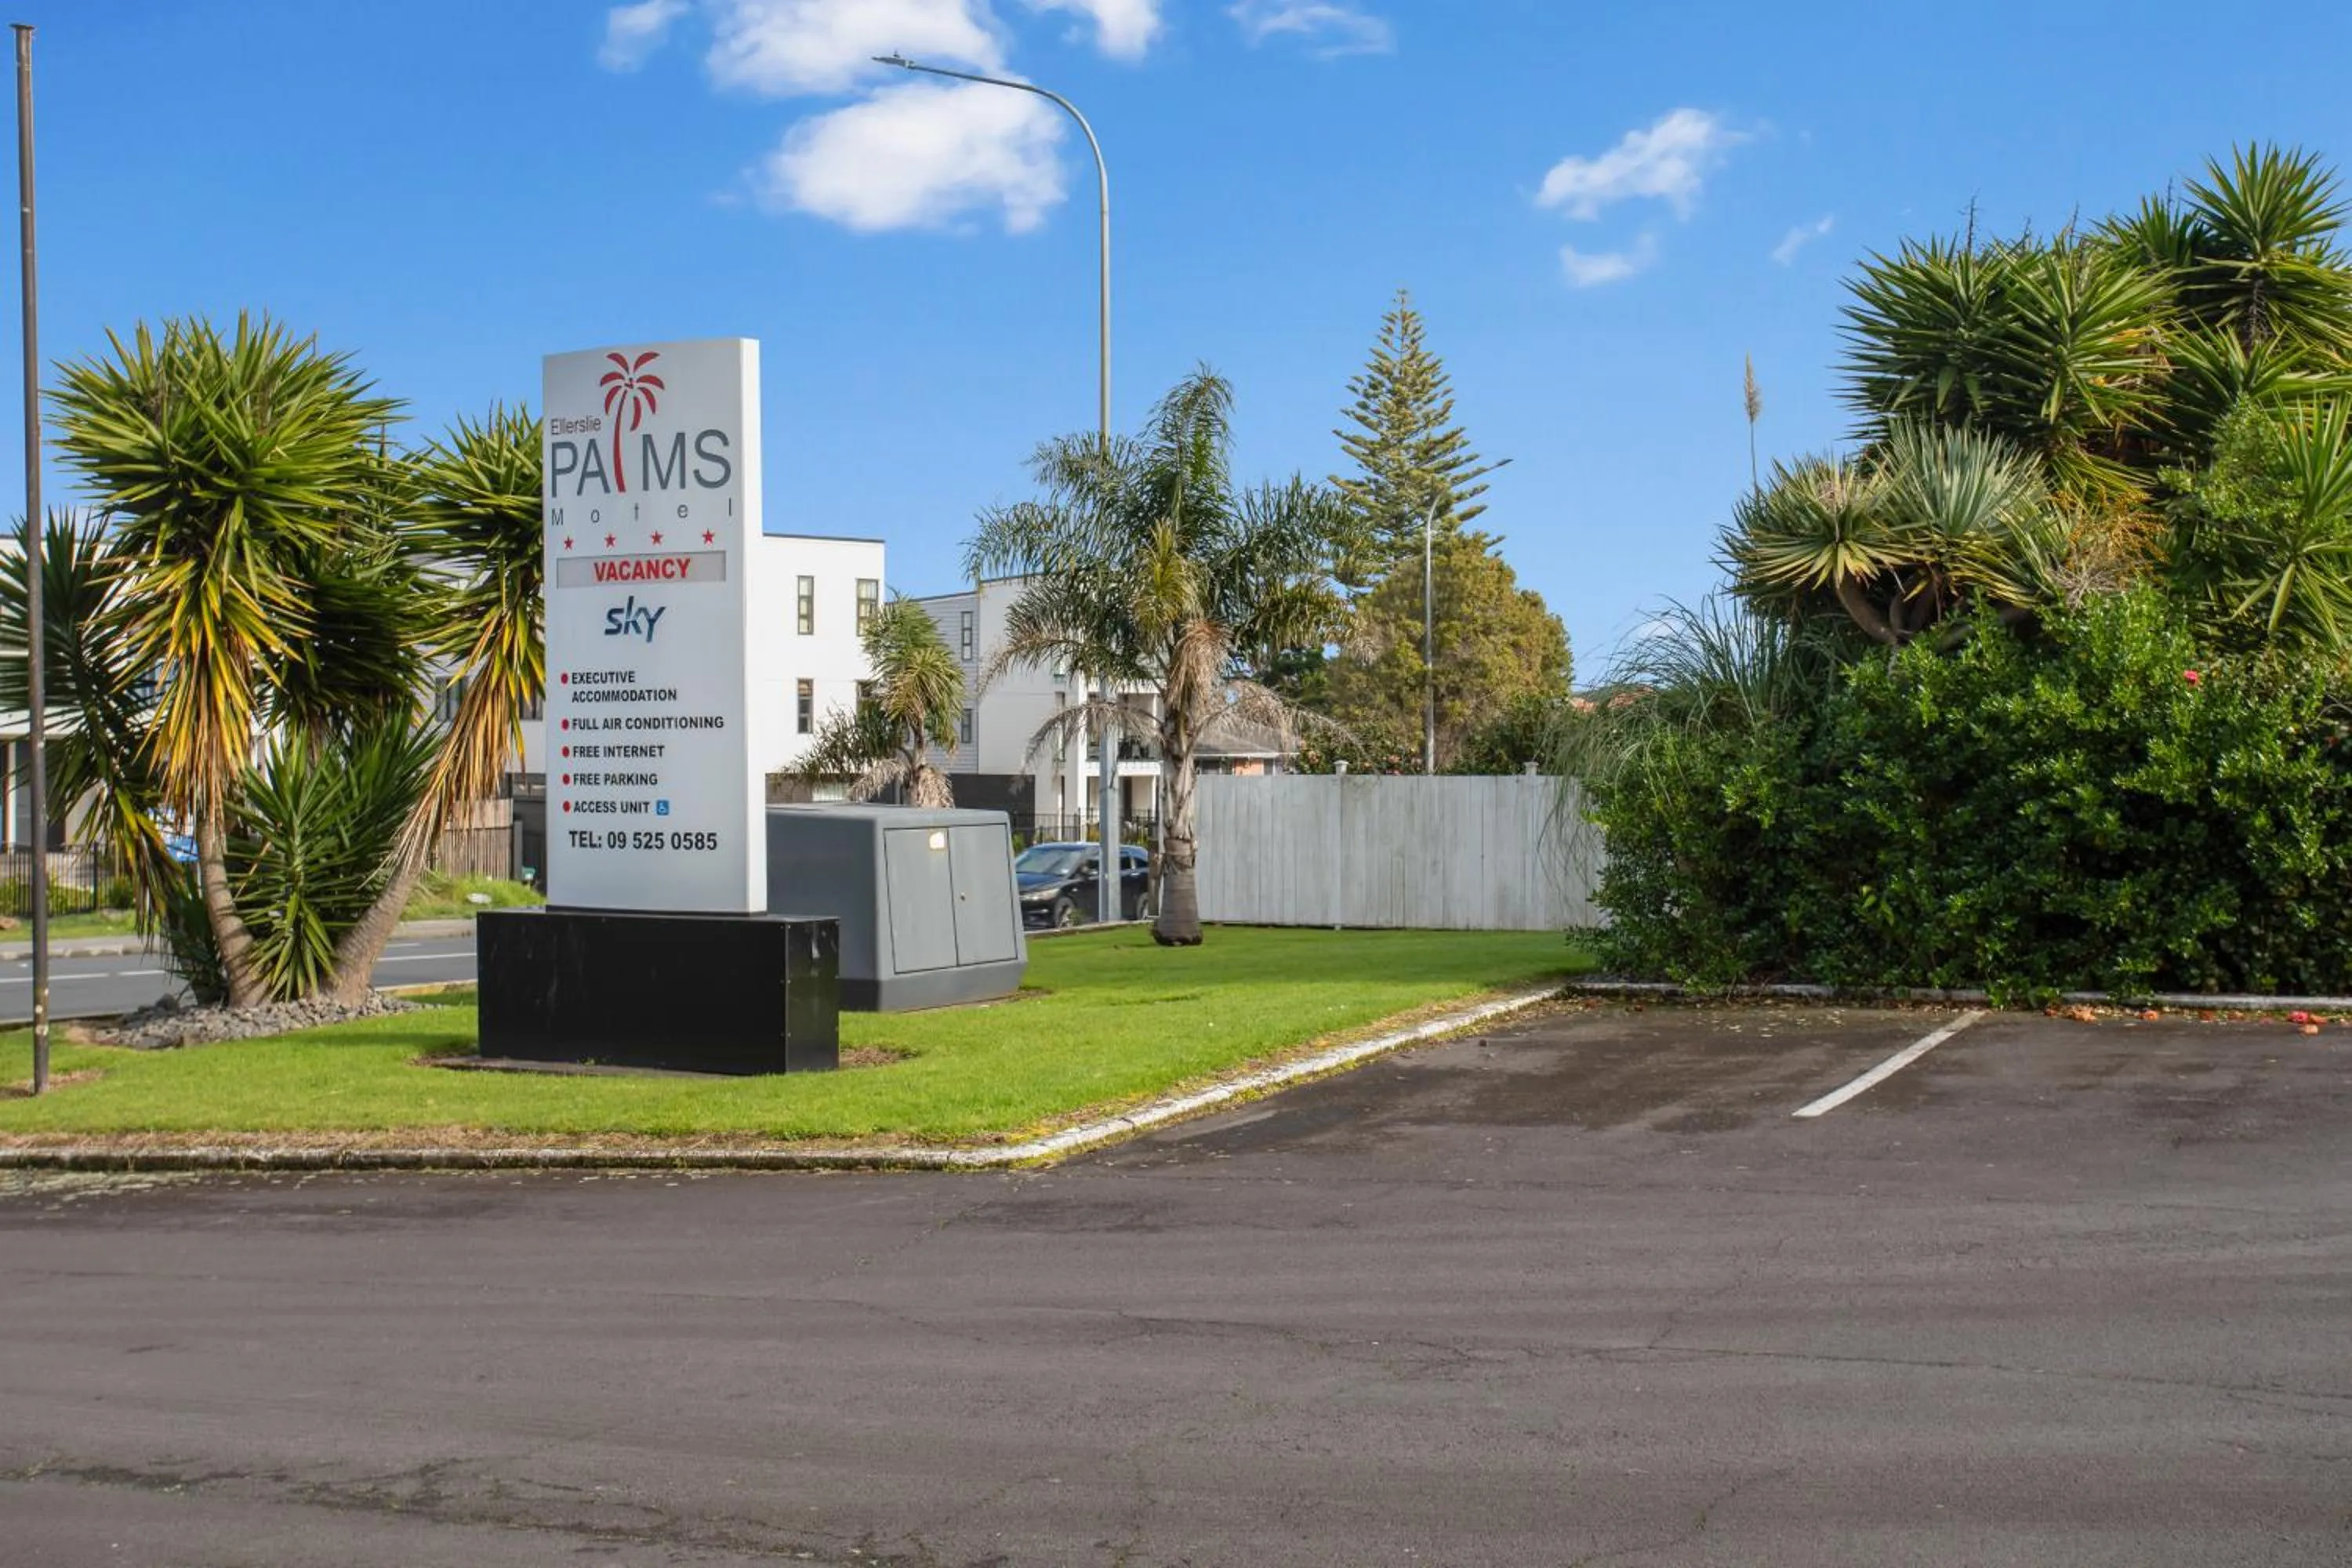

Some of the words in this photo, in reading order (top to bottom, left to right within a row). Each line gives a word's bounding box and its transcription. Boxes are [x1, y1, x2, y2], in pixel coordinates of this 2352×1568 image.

[551, 416, 601, 435] Ellerslie
[593, 557, 691, 582] VACANCY
[572, 671, 636, 684] EXECUTIVE
[572, 689, 677, 702] ACCOMMODATION
[572, 718, 599, 730] FULL
[602, 718, 622, 730] AIR
[625, 717, 724, 729] CONDITIONING
[573, 746, 600, 757] FREE
[603, 746, 665, 757] INTERNET
[573, 774, 601, 786] FREE
[604, 774, 658, 786] PARKING
[573, 801, 617, 813] ACCESS
[620, 802, 650, 813] UNIT
[569, 831, 602, 848] TEL:
[608, 832, 626, 848] 09
[633, 833, 665, 849] 525
[671, 833, 717, 850] 0585
